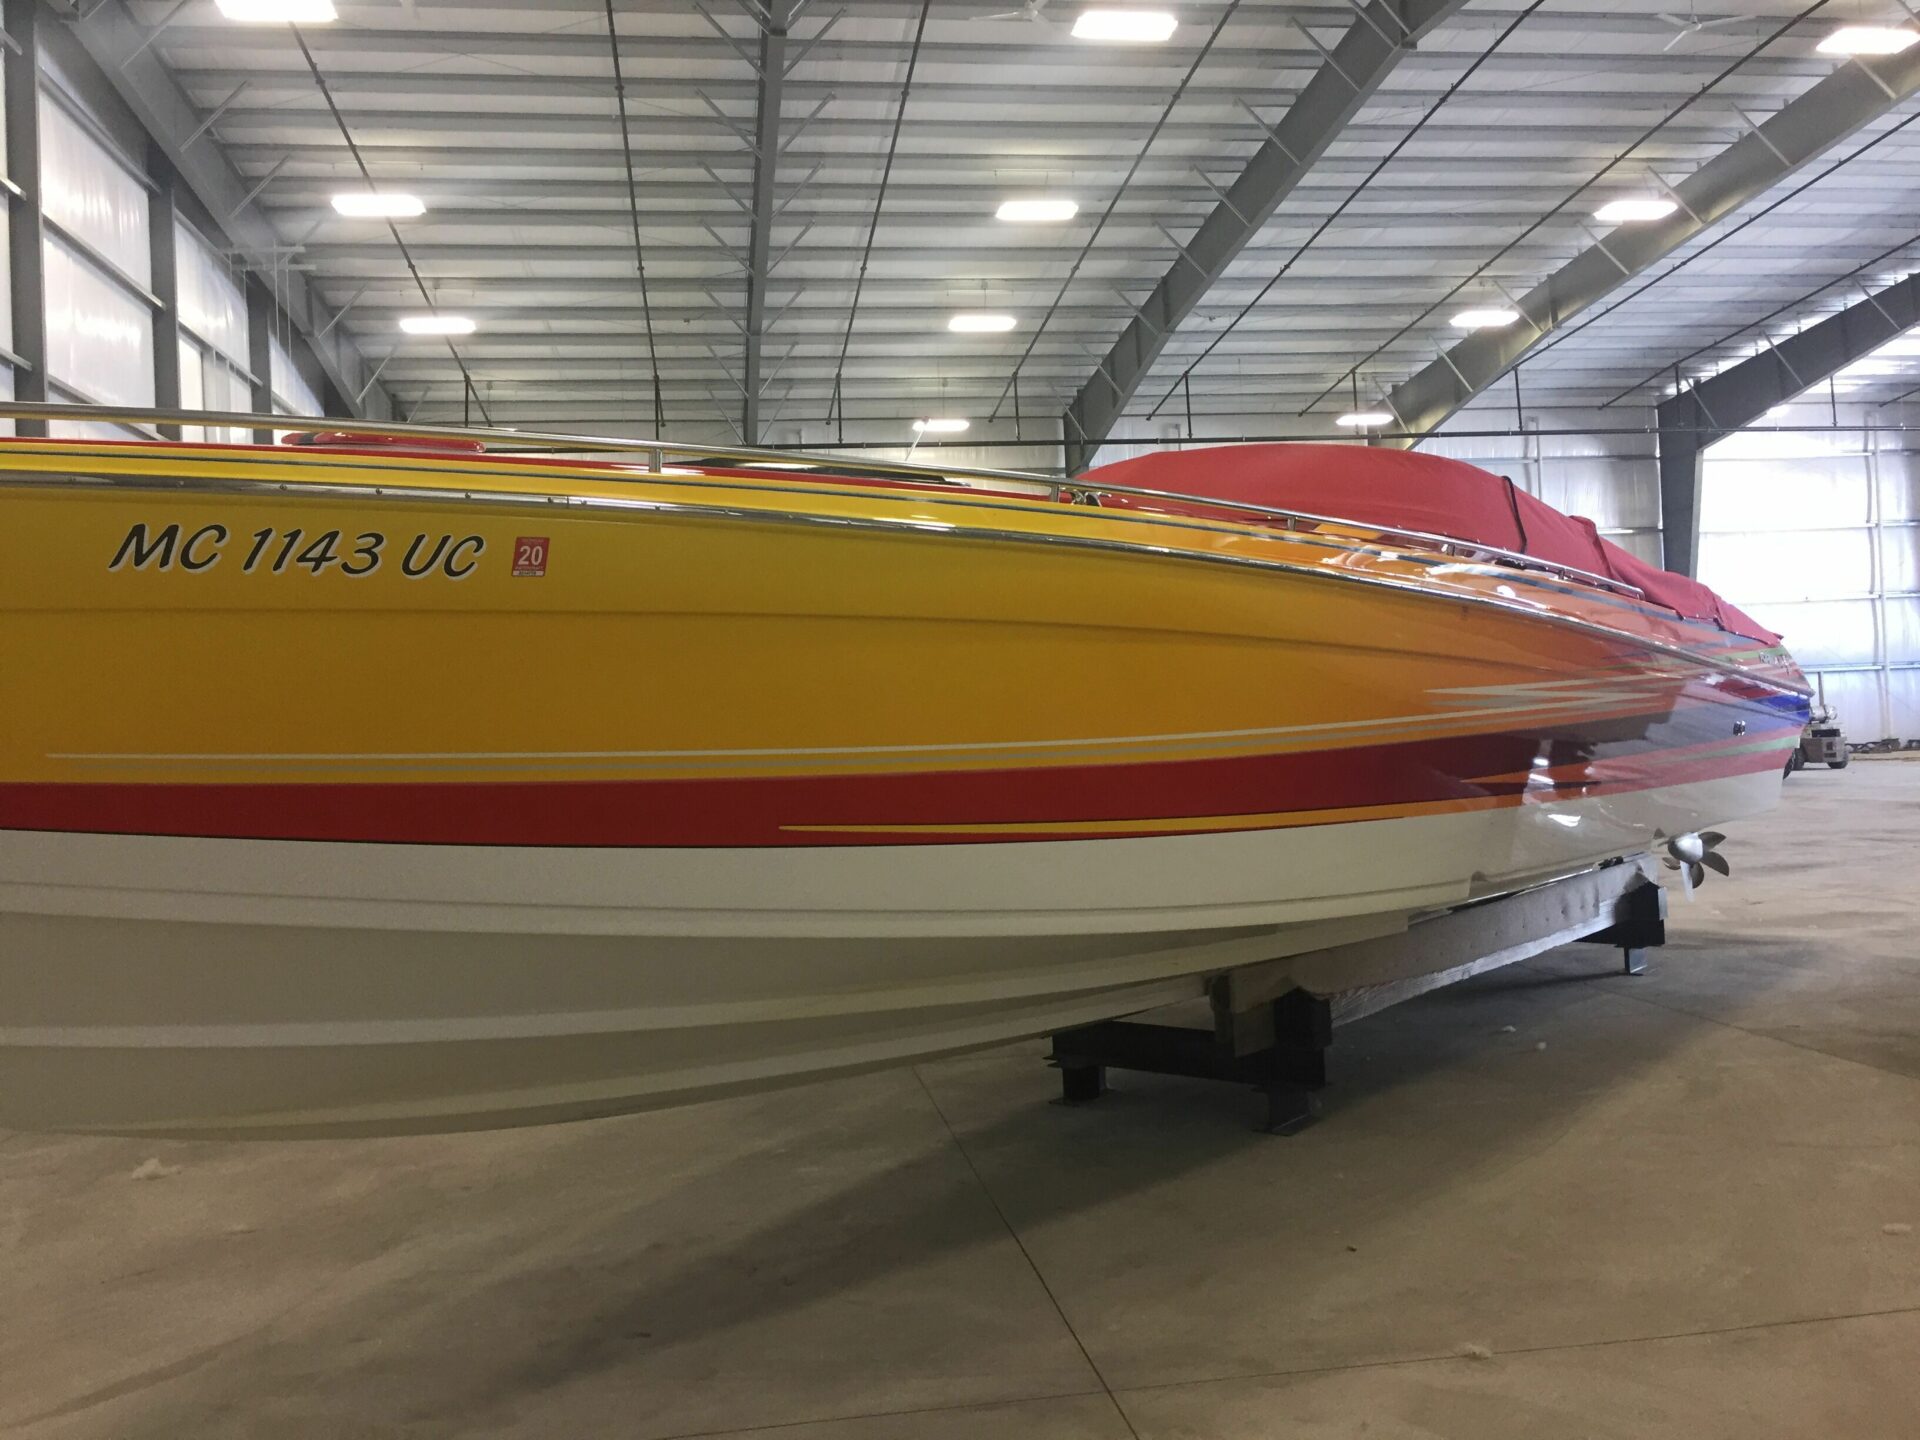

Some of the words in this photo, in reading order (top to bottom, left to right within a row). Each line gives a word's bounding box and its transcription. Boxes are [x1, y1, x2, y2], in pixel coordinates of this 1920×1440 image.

[109, 523, 228, 573] MC
[242, 527, 386, 576] 1143
[401, 533, 486, 579] UC
[517, 545, 543, 566] 20
